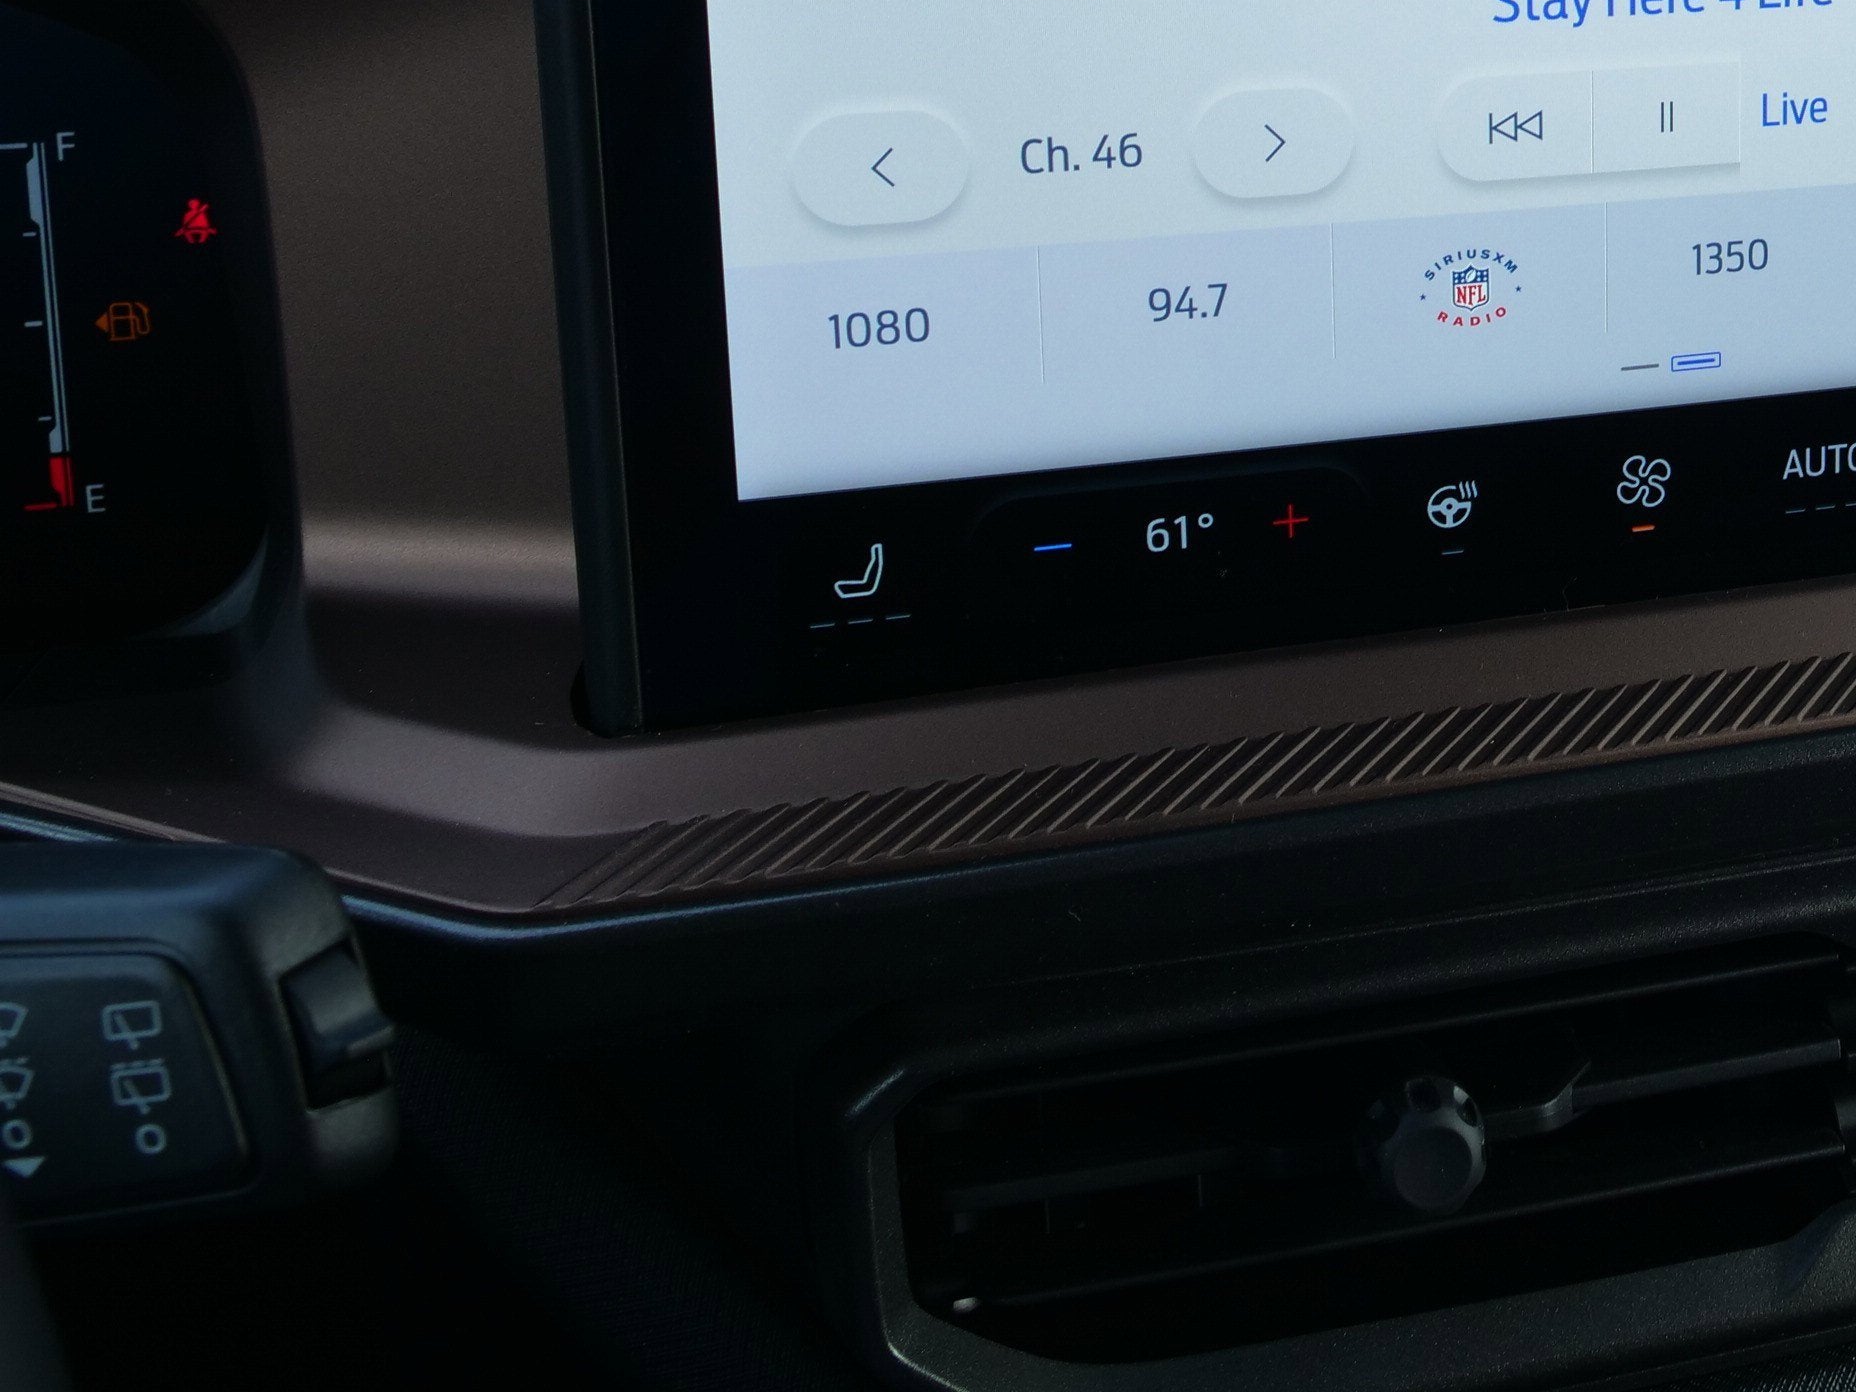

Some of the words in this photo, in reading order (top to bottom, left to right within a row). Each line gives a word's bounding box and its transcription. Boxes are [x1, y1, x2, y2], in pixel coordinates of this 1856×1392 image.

[1760, 91, 1829, 127] Live
[56, 131, 76, 162] F
[1019, 136, 1081, 174] Ch.
[1091, 132, 1144, 170] 46
[1423, 248, 1519, 282] SIRIUSXM
[1690, 237, 1770, 276] 1350
[1147, 282, 1229, 323] 94.7
[1456, 284, 1486, 306] NFL
[827, 307, 931, 350] 1080
[1437, 306, 1507, 327] RADIO
[85, 483, 107, 514] E
[1145, 512, 1215, 554] 61°
